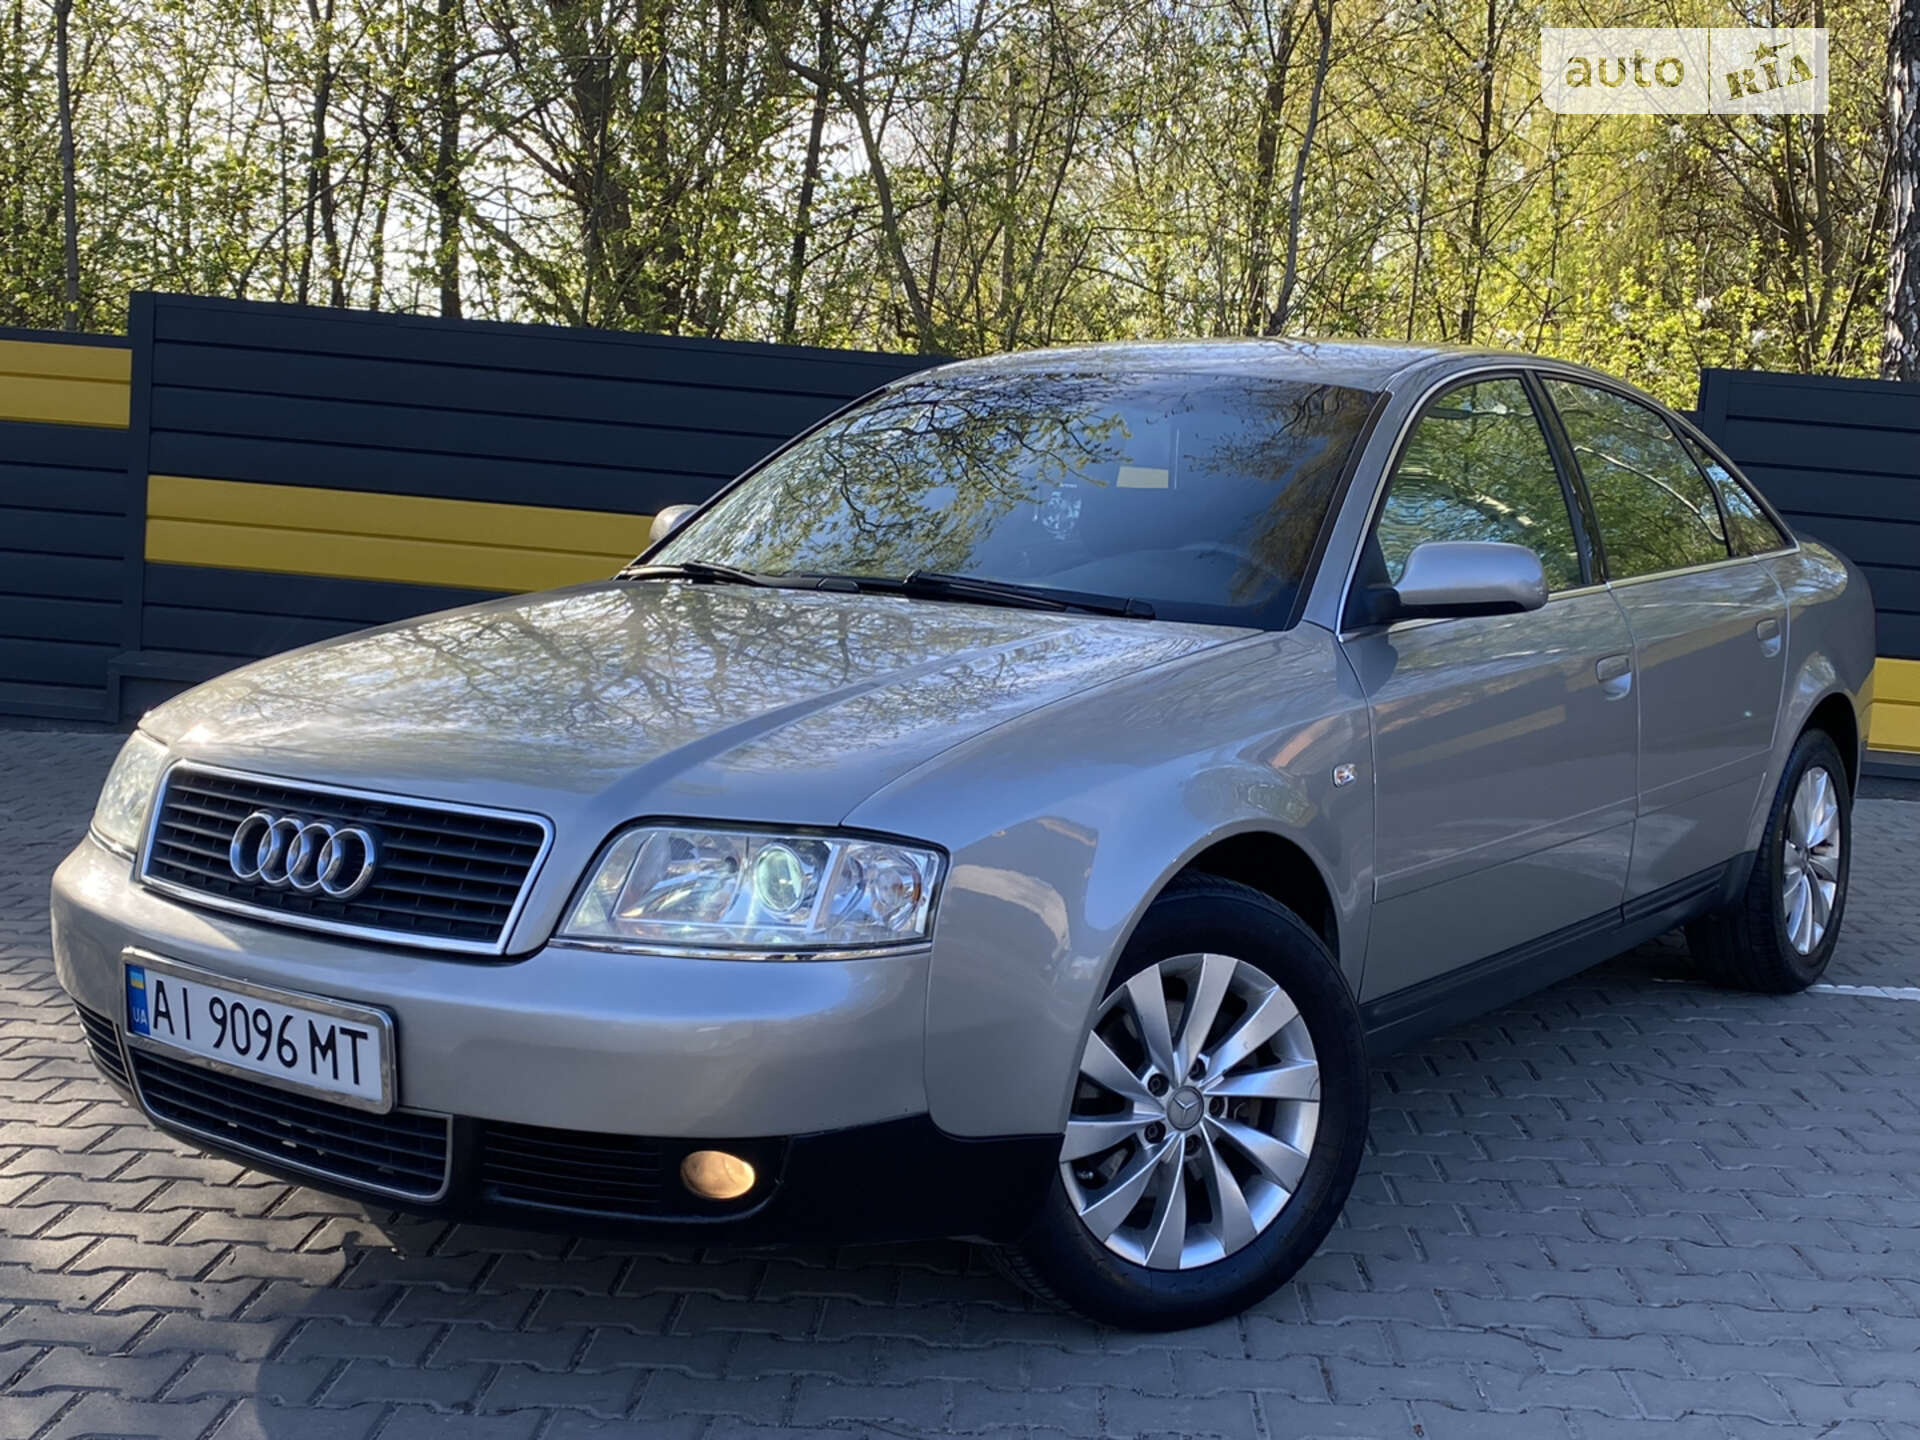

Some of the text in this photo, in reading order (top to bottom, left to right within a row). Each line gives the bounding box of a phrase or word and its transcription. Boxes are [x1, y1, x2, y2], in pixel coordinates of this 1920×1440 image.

[132, 1007, 148, 1025] UA
[153, 979, 368, 1085] AI 9096 MT
